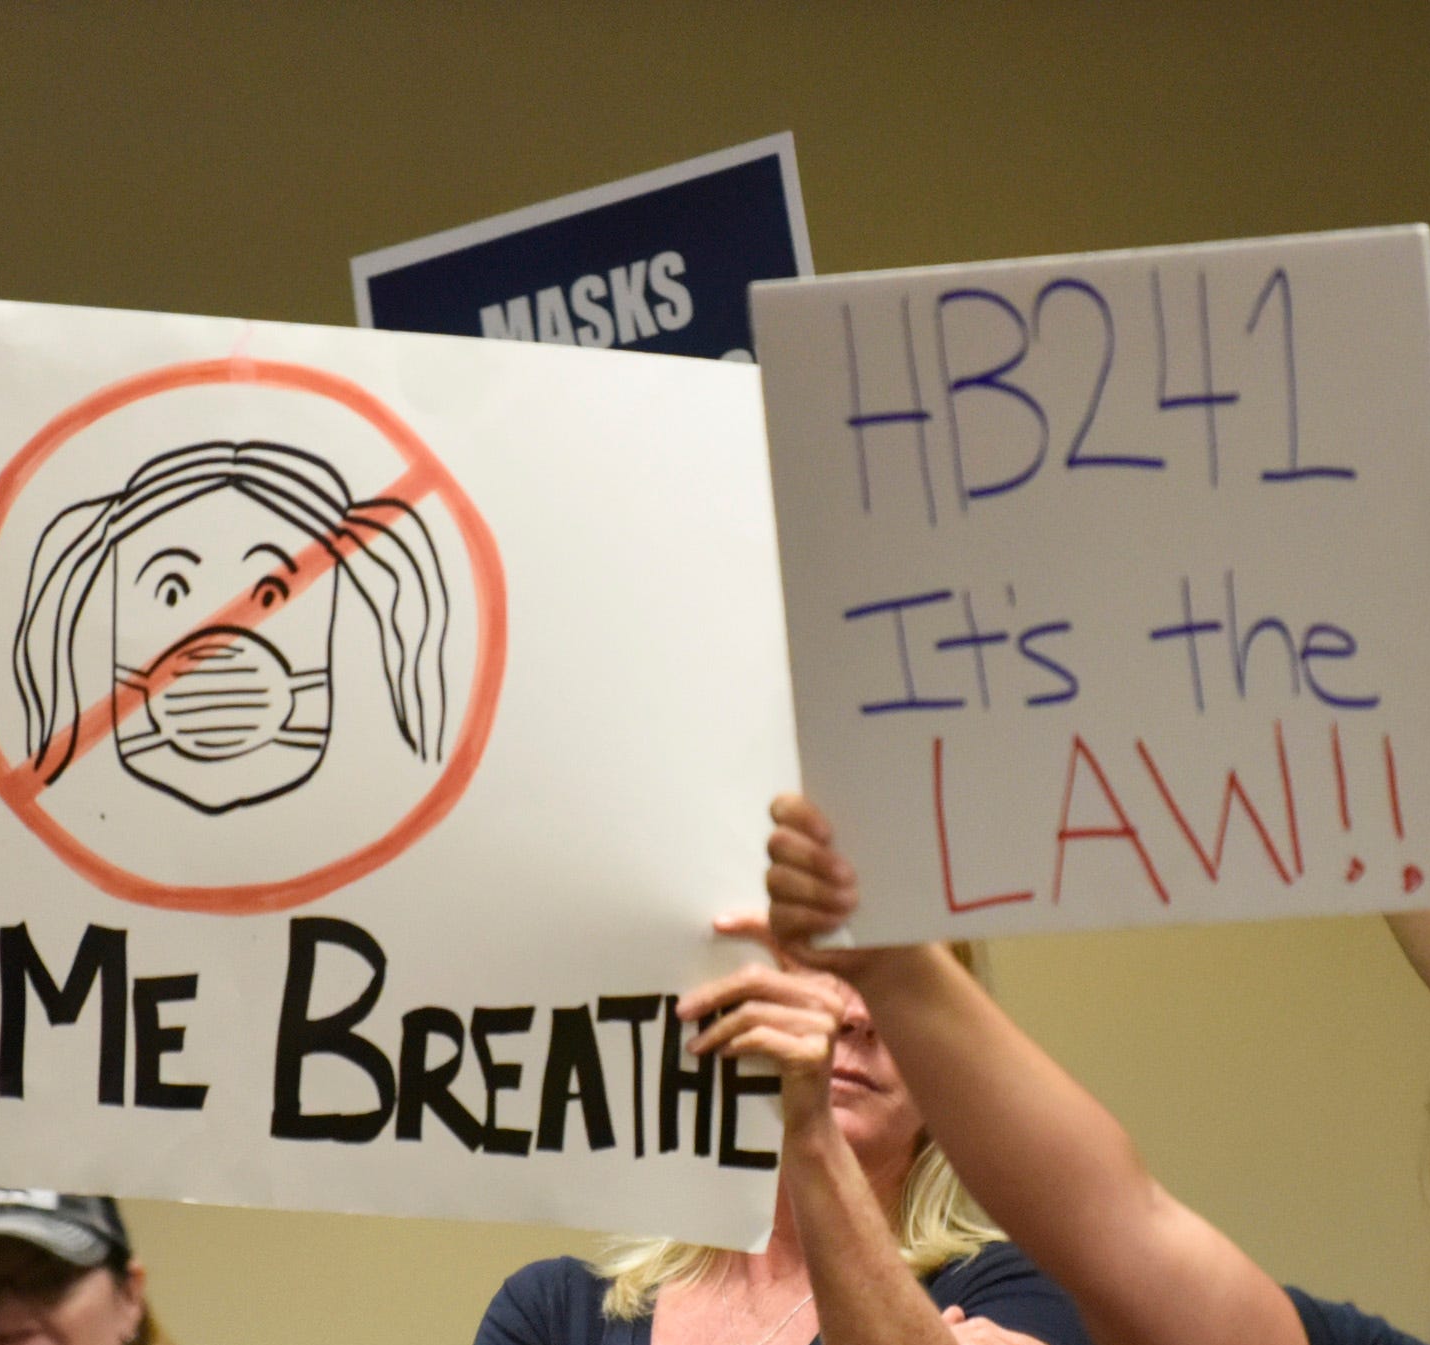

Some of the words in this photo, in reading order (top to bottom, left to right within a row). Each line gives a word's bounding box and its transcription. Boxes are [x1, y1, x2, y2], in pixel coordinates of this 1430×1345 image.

[479, 250, 694, 350] MASKS
[845, 266, 1357, 528] HB241
[845, 582, 1080, 715] It's
[1150, 569, 1381, 713] the
[932, 718, 1424, 914] LAW!!
[269, 916, 782, 1170] BREATHE
